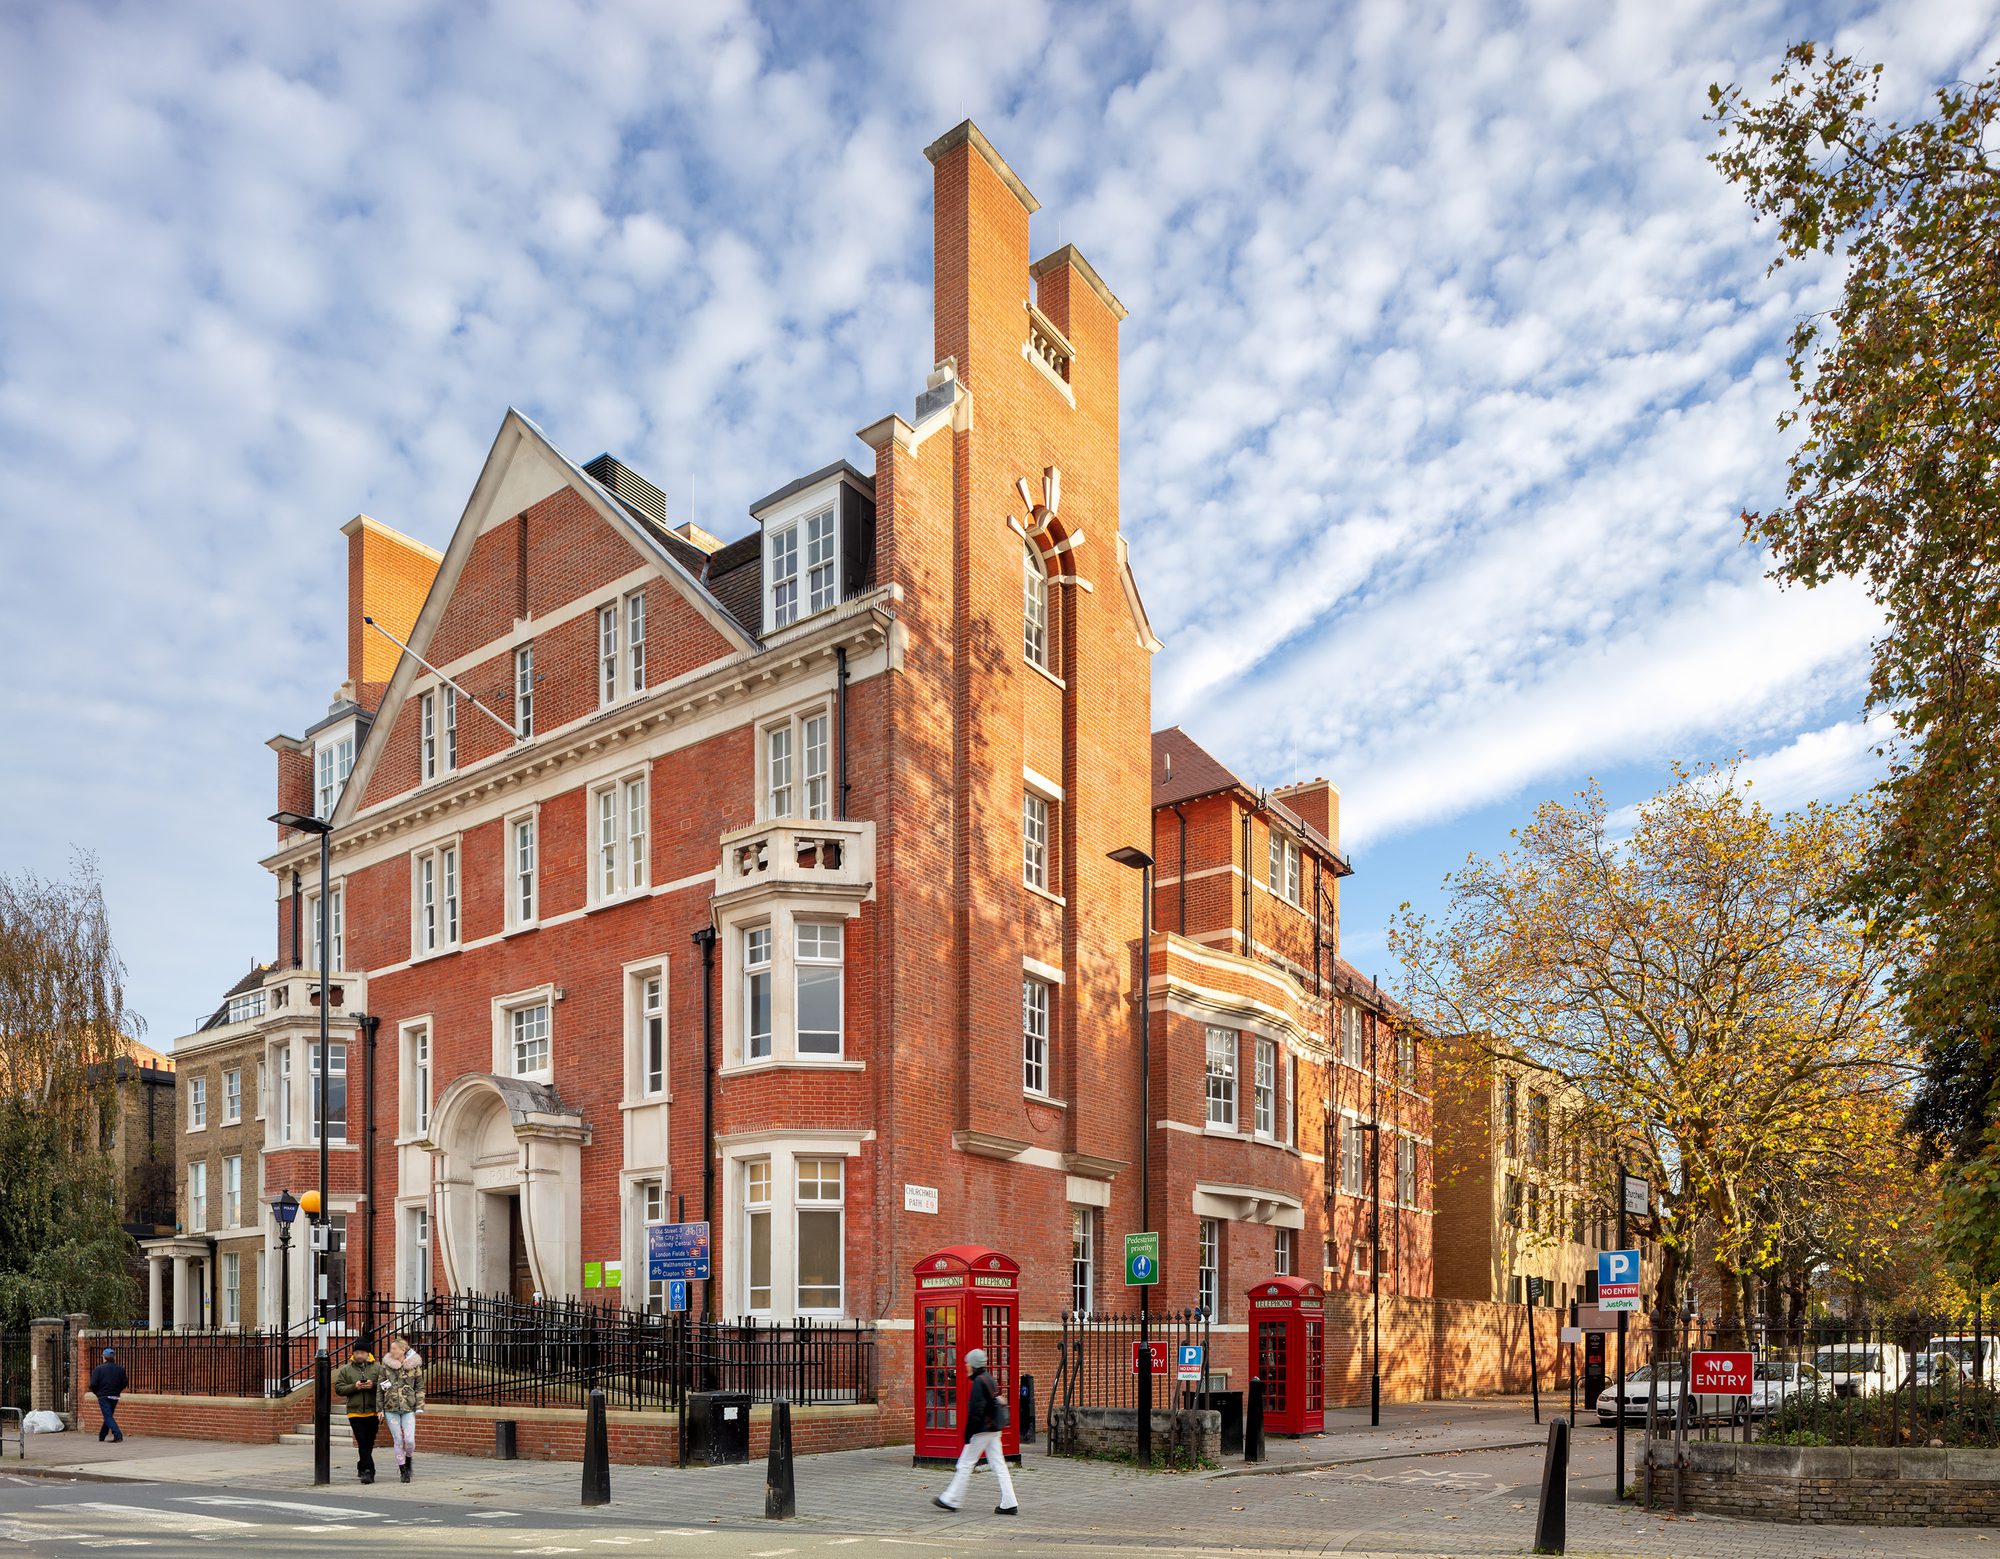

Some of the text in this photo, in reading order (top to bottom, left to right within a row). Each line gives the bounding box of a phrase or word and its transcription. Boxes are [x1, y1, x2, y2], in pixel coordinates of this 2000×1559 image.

[906, 1186, 936, 1198] CHURCHWELL
[1625, 1187, 1645, 1201] Churchwell
[909, 1199, 922, 1208] PATH
[1127, 1236, 1157, 1244] Pedestrian
[1131, 1244, 1152, 1253] priority
[1610, 1254, 1629, 1282] P
[976, 1277, 1011, 1286] TELEPHONE
[1601, 1287, 1637, 1296] NO ENTRY
[1605, 1300, 1633, 1308] JustPark
[1185, 1348, 1196, 1364] P
[1709, 1360, 1733, 1372] NO
[1696, 1374, 1747, 1386] ENTRY
